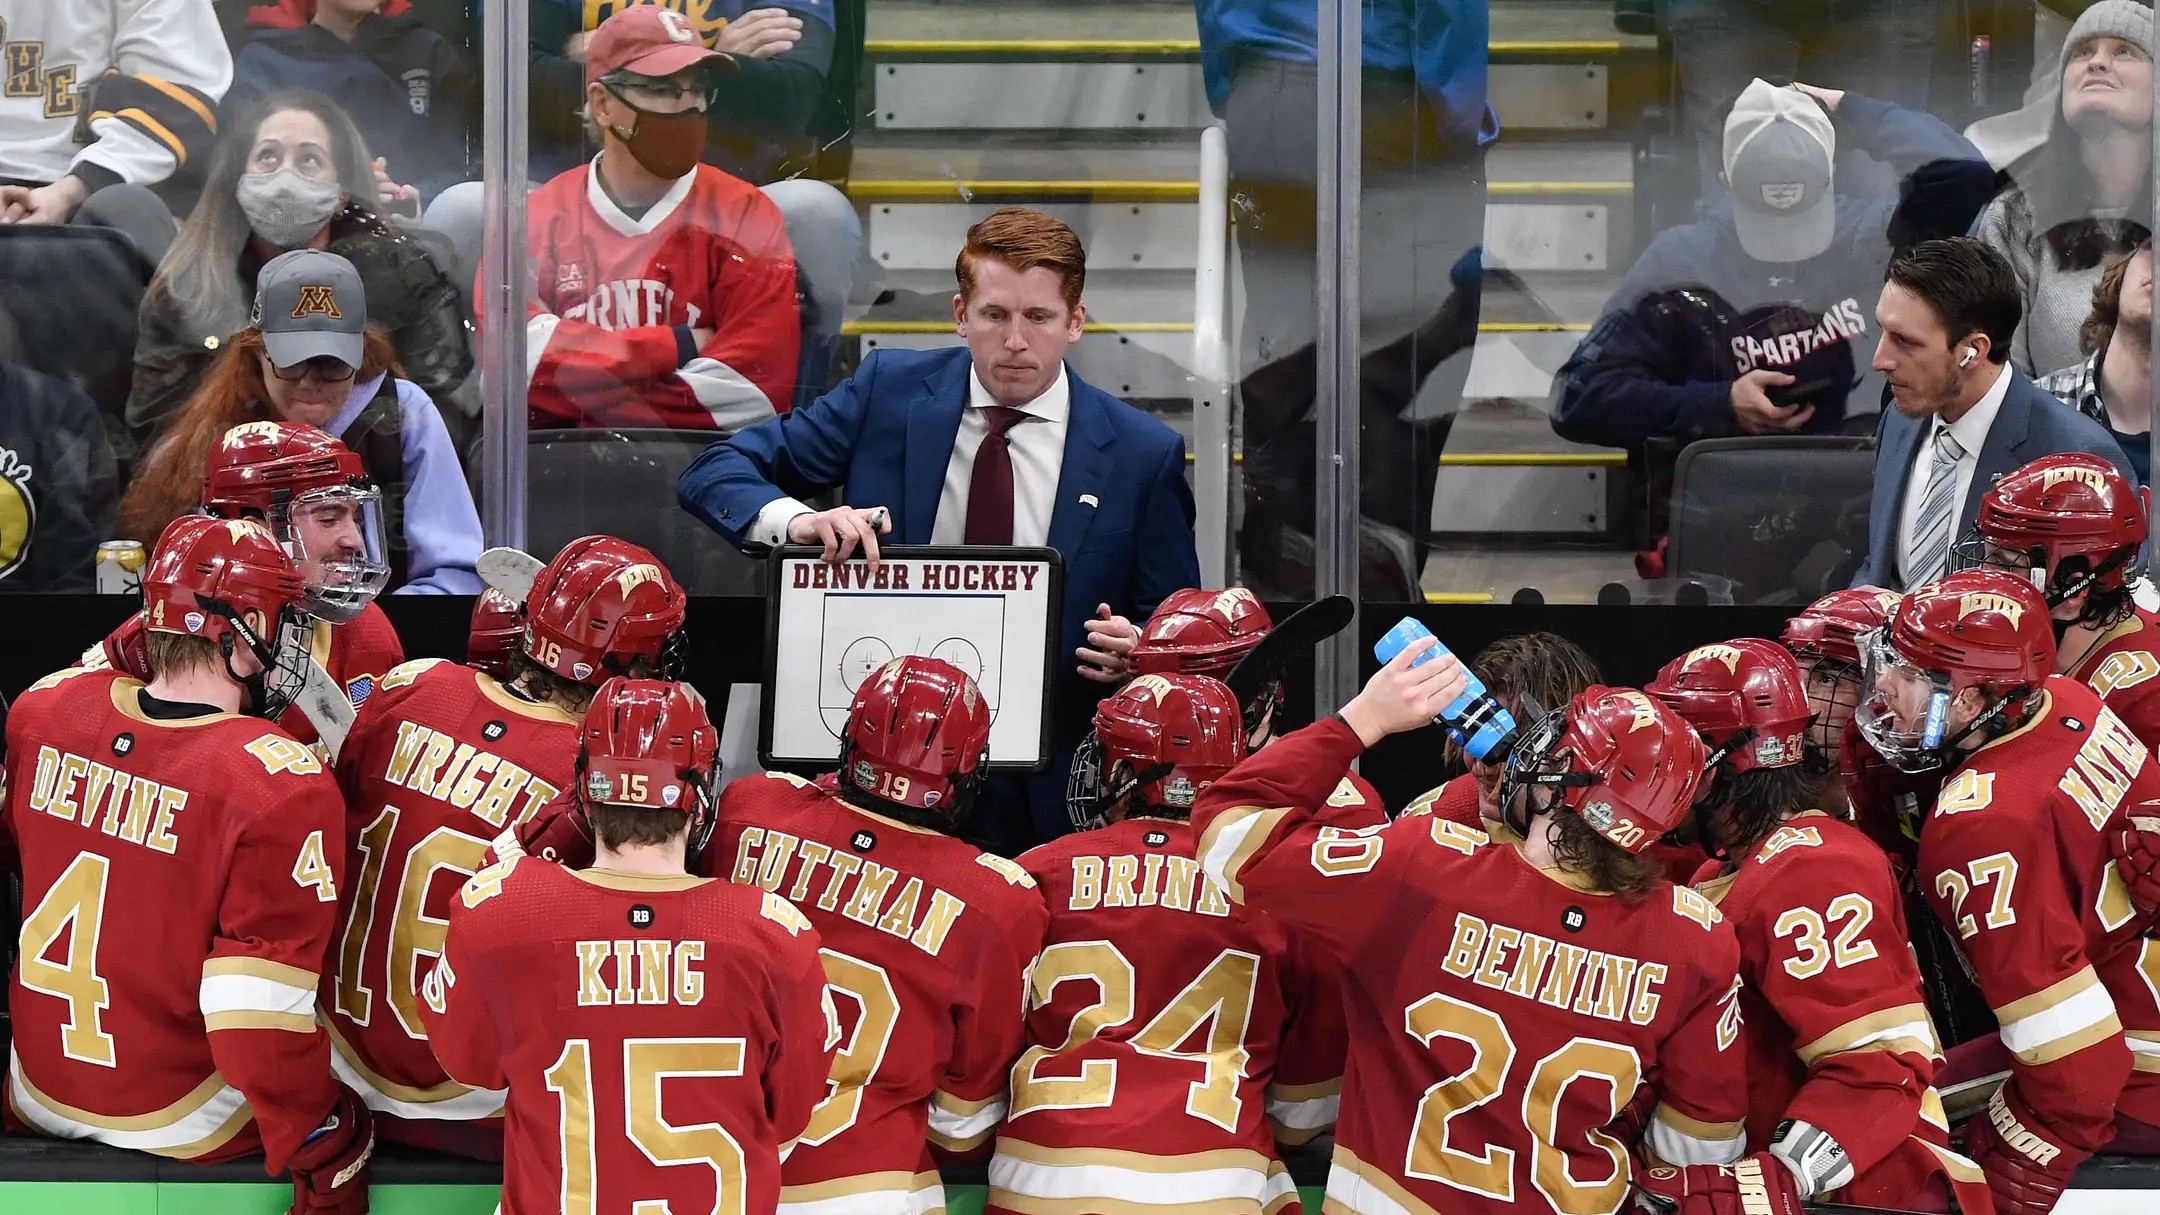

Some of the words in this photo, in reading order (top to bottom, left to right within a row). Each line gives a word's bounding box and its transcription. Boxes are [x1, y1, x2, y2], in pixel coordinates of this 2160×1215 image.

[658, 10, 693, 42] C
[291, 284, 342, 320] M
[1731, 298, 1866, 374] SPARTANS
[2043, 466, 2108, 500] DENVER
[793, 563, 909, 590] DENVER
[922, 565, 1039, 591] HOCKEY
[153, 599, 165, 626] 4
[1958, 593, 2025, 632] DENVER
[536, 636, 562, 669] 16
[115, 736, 131, 752] RB
[484, 723, 501, 738] RB
[384, 720, 560, 829] WRIGHT
[619, 773, 649, 802] 15
[880, 771, 911, 801] 19
[29, 744, 189, 855] DEVINE
[854, 833, 873, 849] RB
[1147, 833, 1165, 844] RB
[1606, 818, 1646, 848] 20
[292, 830, 337, 902] 4
[731, 826, 966, 957] GUTTMAN
[1935, 851, 2019, 940] 27
[335, 804, 492, 1040] 16
[633, 910, 650, 923] RB
[1565, 911, 1583, 928] RB
[1773, 892, 1879, 980] 32
[18, 850, 117, 1068] 4
[576, 940, 706, 1006] KING
[1440, 912, 1669, 1026] BENNING
[1007, 940, 1261, 1134] 24
[1405, 992, 1643, 1215] 20
[543, 1038, 747, 1215] 15
